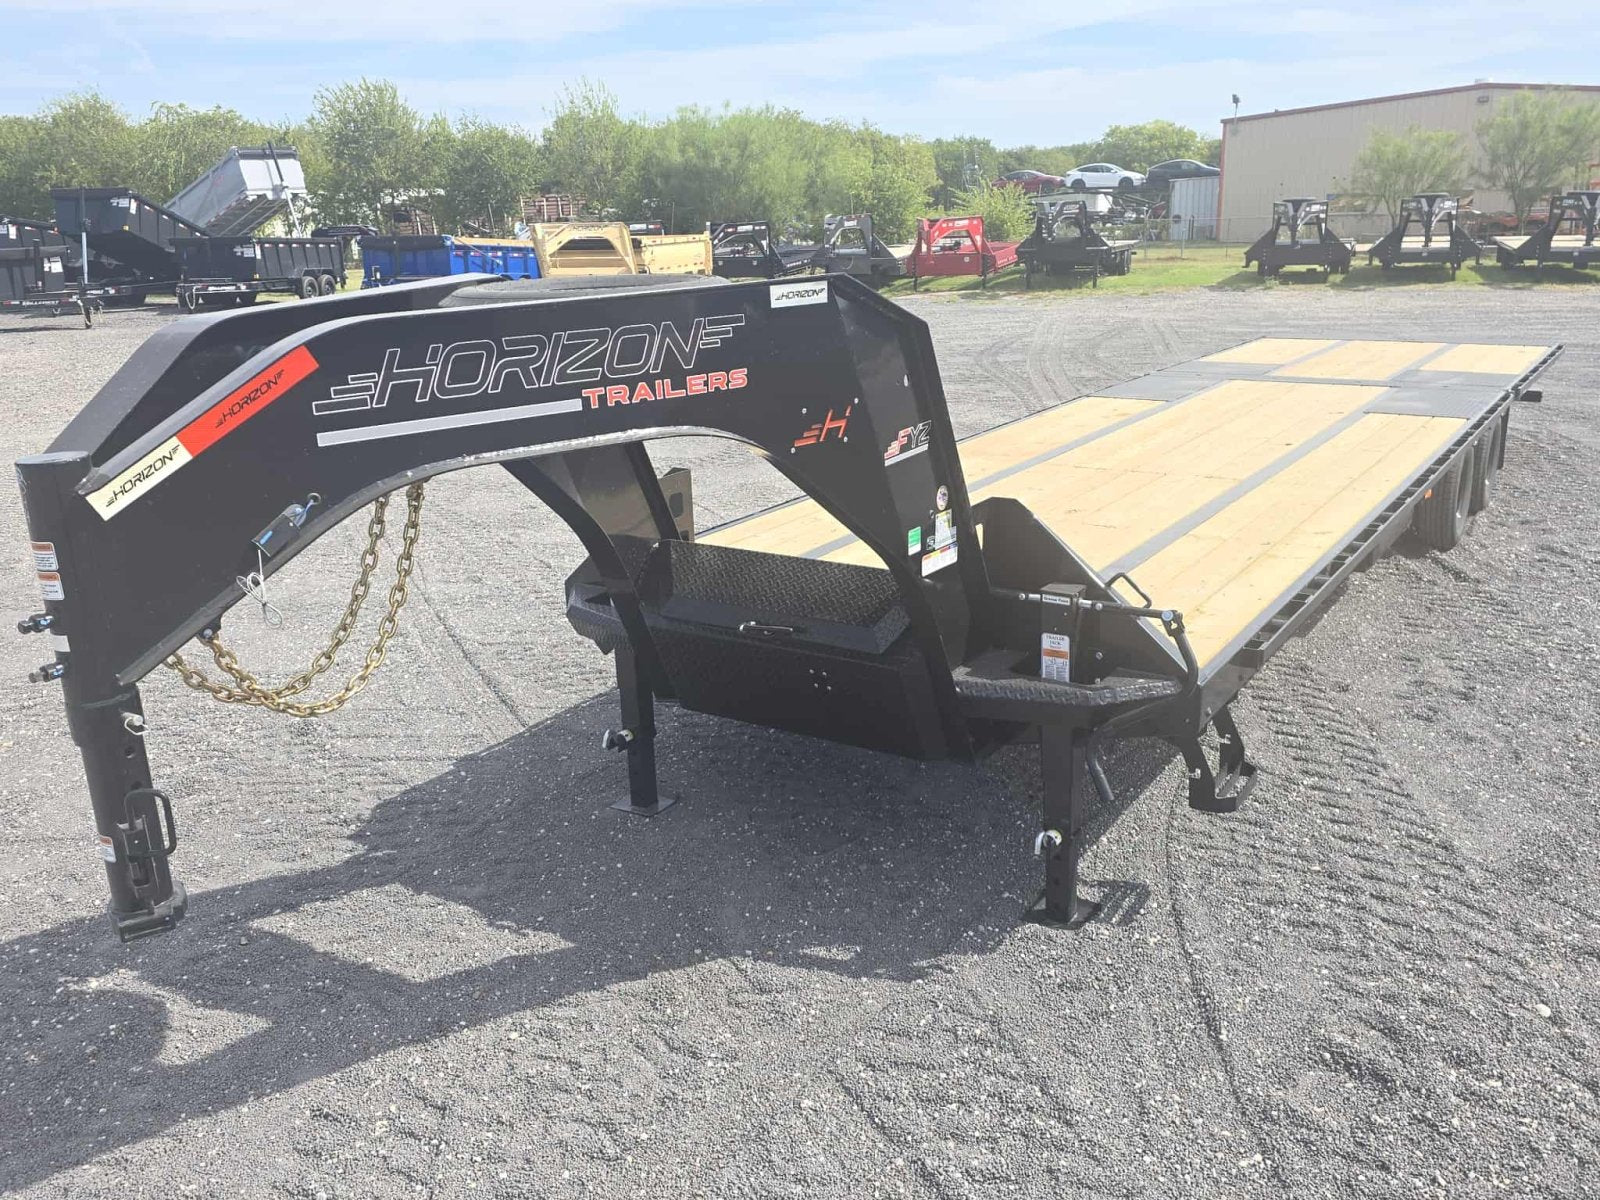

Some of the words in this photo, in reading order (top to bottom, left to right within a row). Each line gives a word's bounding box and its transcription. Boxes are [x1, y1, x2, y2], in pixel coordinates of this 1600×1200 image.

[780, 288, 821, 300] HORIZON
[371, 317, 705, 408] HORIZON
[220, 374, 281, 425] HORIZON
[582, 368, 748, 409] TRAILERS
[111, 450, 175, 502] HORIZON
